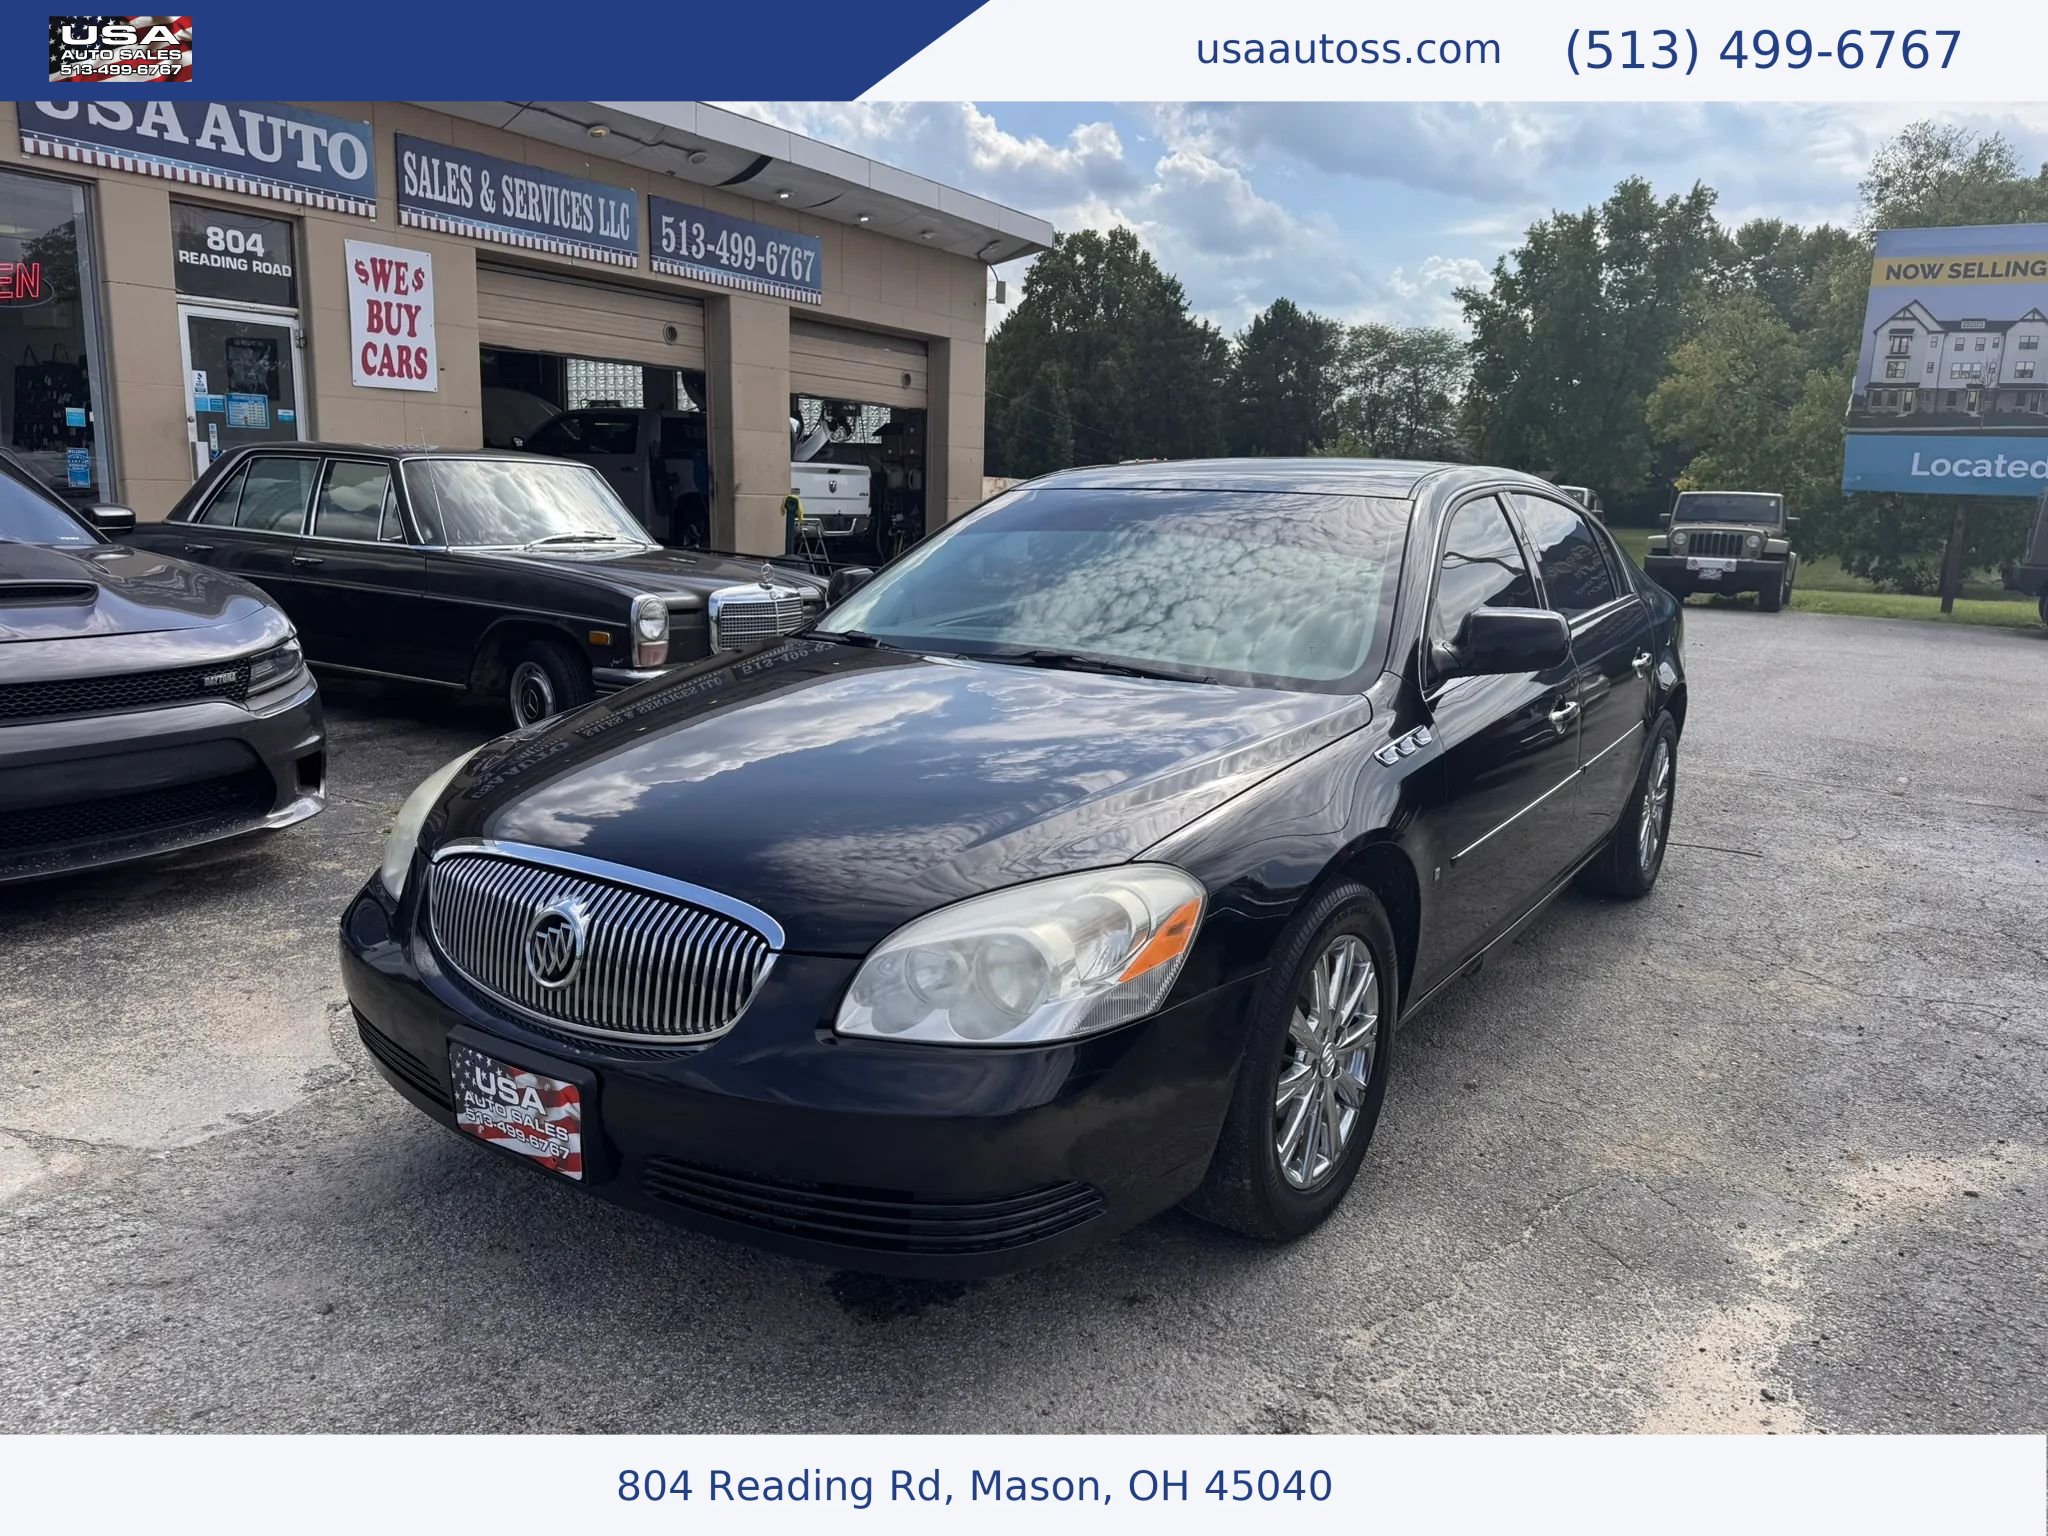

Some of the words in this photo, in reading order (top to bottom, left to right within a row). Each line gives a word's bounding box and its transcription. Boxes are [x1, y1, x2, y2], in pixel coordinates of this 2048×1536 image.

[196, 102, 368, 180] AUTO
[403, 150, 473, 208] SALES
[480, 170, 496, 214] &
[502, 174, 594, 234] SERVICES
[599, 198, 630, 241] LLC
[179, 250, 248, 271] READING
[253, 261, 292, 277] ROAD
[206, 226, 264, 257] 804
[661, 215, 815, 282] 513-499-6767
[1886, 263, 1944, 280] NOW
[1947, 260, 2047, 278] SELLING
[367, 299, 421, 337] BUY
[361, 341, 427, 379] CARS
[1911, 452, 2048, 479] Located
[474, 1066, 547, 1116] USA
[464, 1090, 507, 1117] AUTO
[512, 1110, 569, 1142] SALES
[465, 1107, 570, 1160] 513-499-6767
